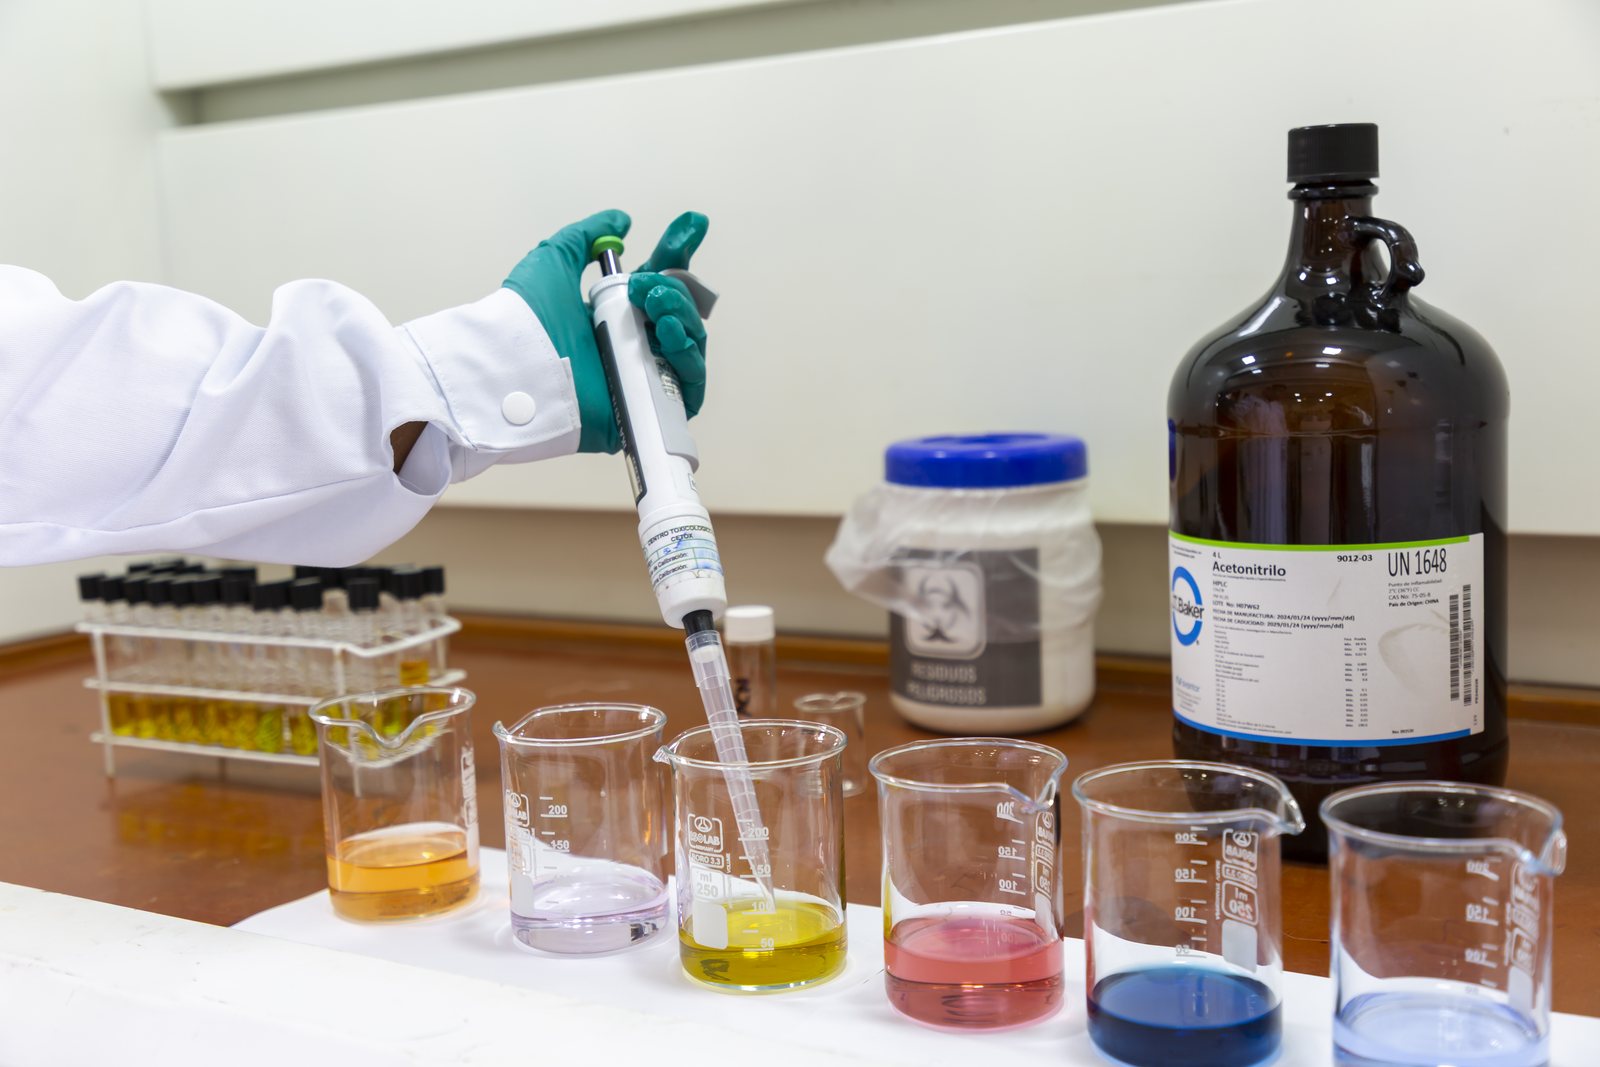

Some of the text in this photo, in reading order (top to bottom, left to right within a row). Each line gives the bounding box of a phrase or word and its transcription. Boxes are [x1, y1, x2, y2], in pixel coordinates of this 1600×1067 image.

[647, 531, 669, 546] CENTRO
[1212, 551, 1217, 559] 4
[1337, 554, 1373, 563] 9012-03
[1388, 548, 1447, 577] UN 1648
[1212, 561, 1286, 577] Acetonitrilo
[1276, 613, 1311, 621] 2024/01/24
[1311, 615, 1355, 623] (yyyy/mm/dd)
[1266, 621, 1301, 629] 2029/01/24
[1300, 622, 1345, 630] (yyyy/mm/dd)
[548, 804, 568, 815] 200
[749, 827, 769, 838] 200
[690, 833, 720, 846] ISOLAB
[550, 840, 570, 850] 150
[710, 857, 721, 866] 3.3
[700, 872, 712, 882] ml
[696, 883, 719, 897] 250
[760, 938, 774, 948] 50
